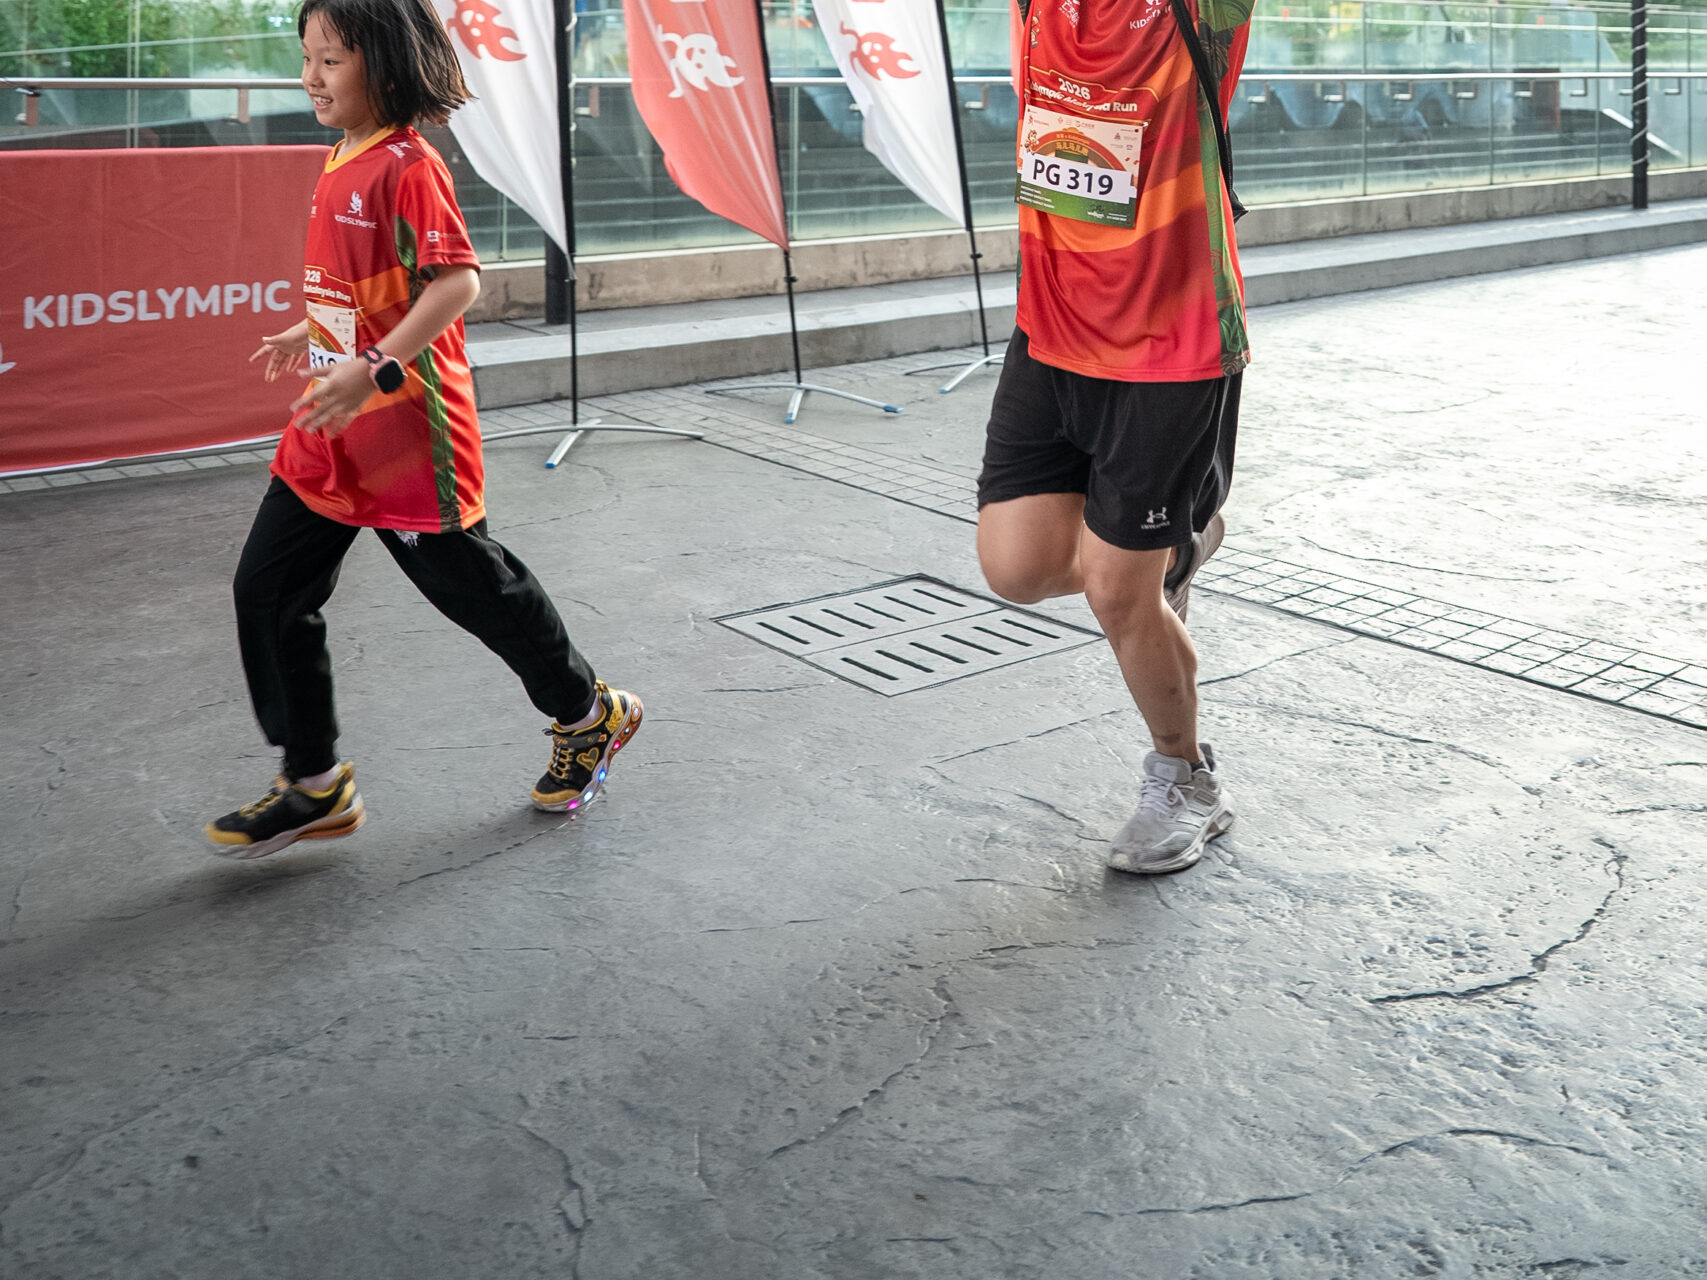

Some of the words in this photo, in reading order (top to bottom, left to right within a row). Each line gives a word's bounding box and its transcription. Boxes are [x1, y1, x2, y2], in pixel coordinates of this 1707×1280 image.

[1058, 77, 1091, 101] 2026
[1112, 101, 1138, 113] Run
[1032, 158, 1061, 186] PG
[1066, 168, 1114, 196] 319
[23, 280, 292, 330] KIDSLYMPIC
